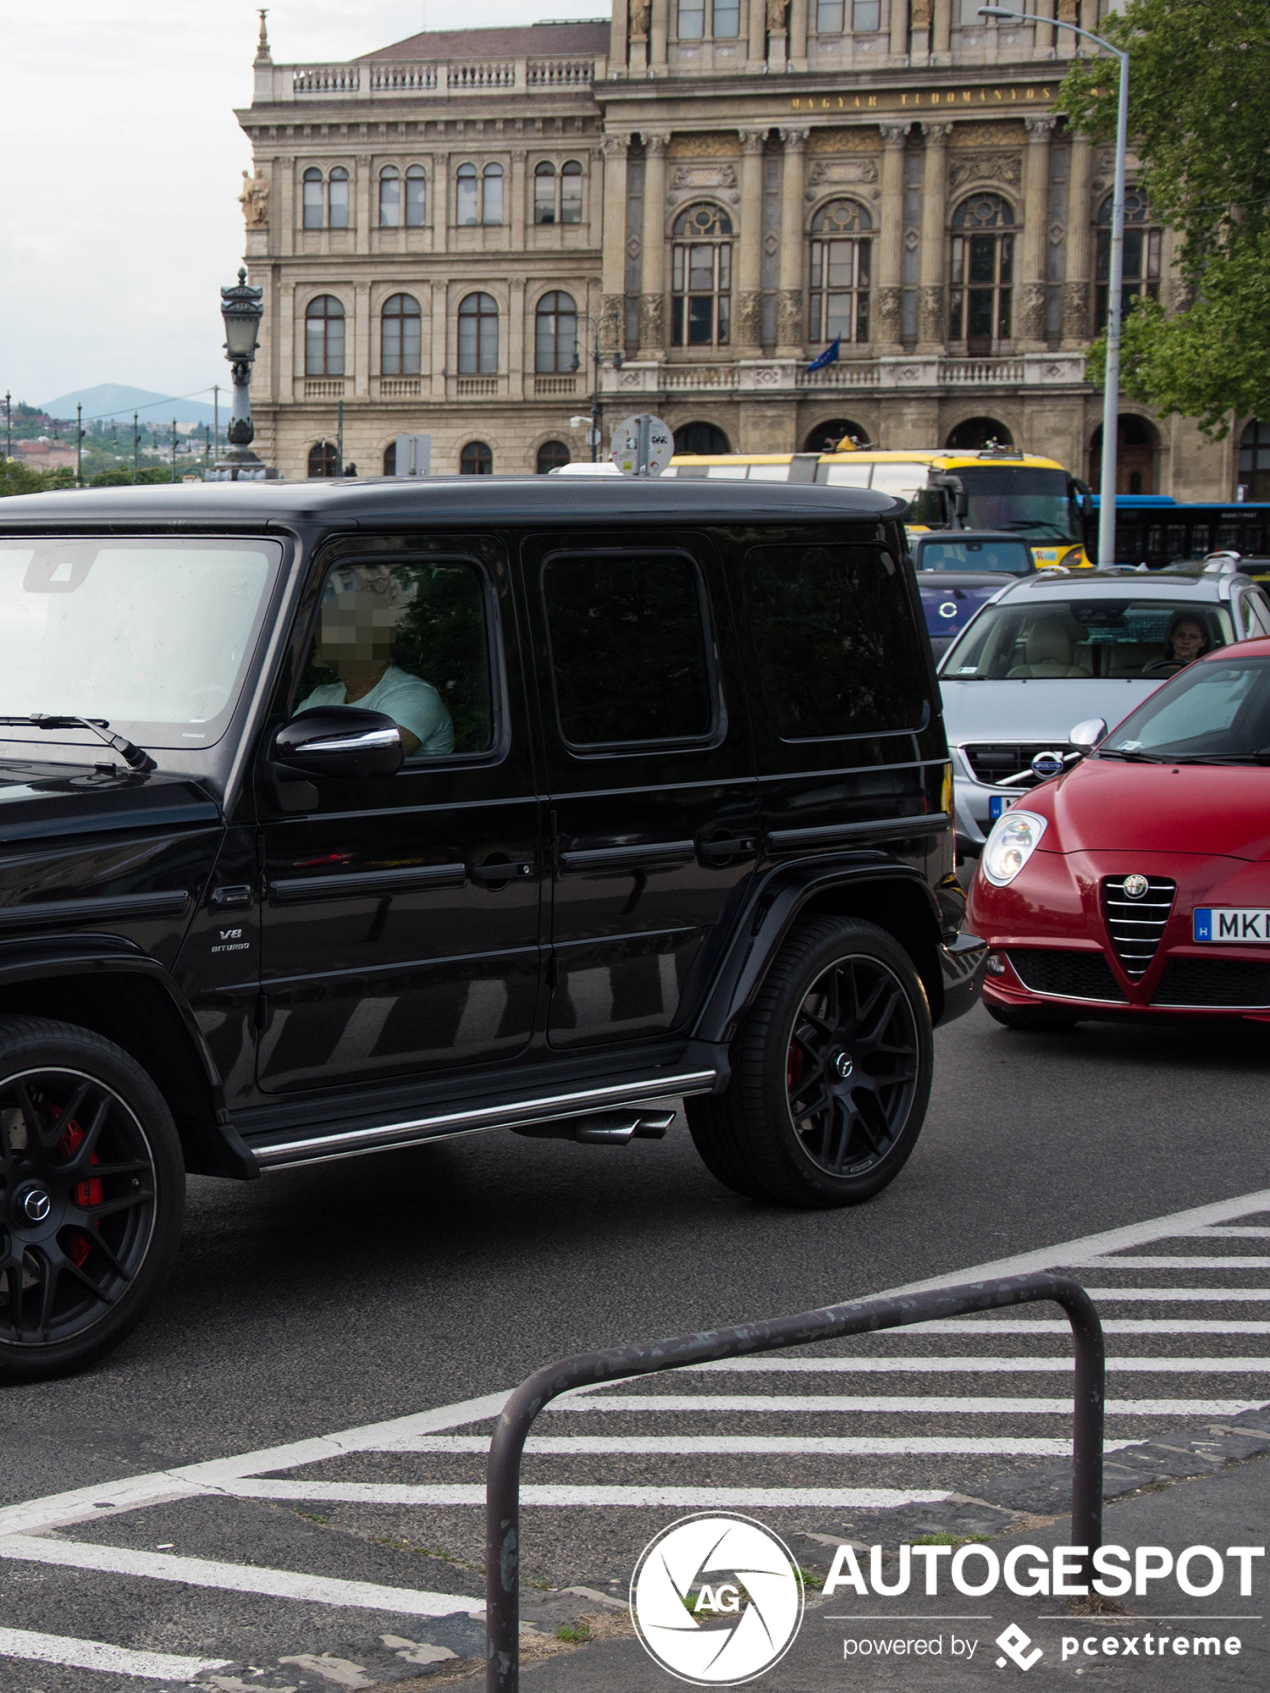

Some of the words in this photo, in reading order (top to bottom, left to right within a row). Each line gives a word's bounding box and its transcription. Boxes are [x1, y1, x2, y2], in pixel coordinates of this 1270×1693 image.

[791, 95, 877, 109] MAGYAR
[900, 87, 1051, 105] TUDOMÁNYOS
[1219, 913, 1270, 938] MK
[219, 929, 242, 939] V8
[1199, 927, 1208, 936] H
[211, 942, 250, 953] BITURBO
